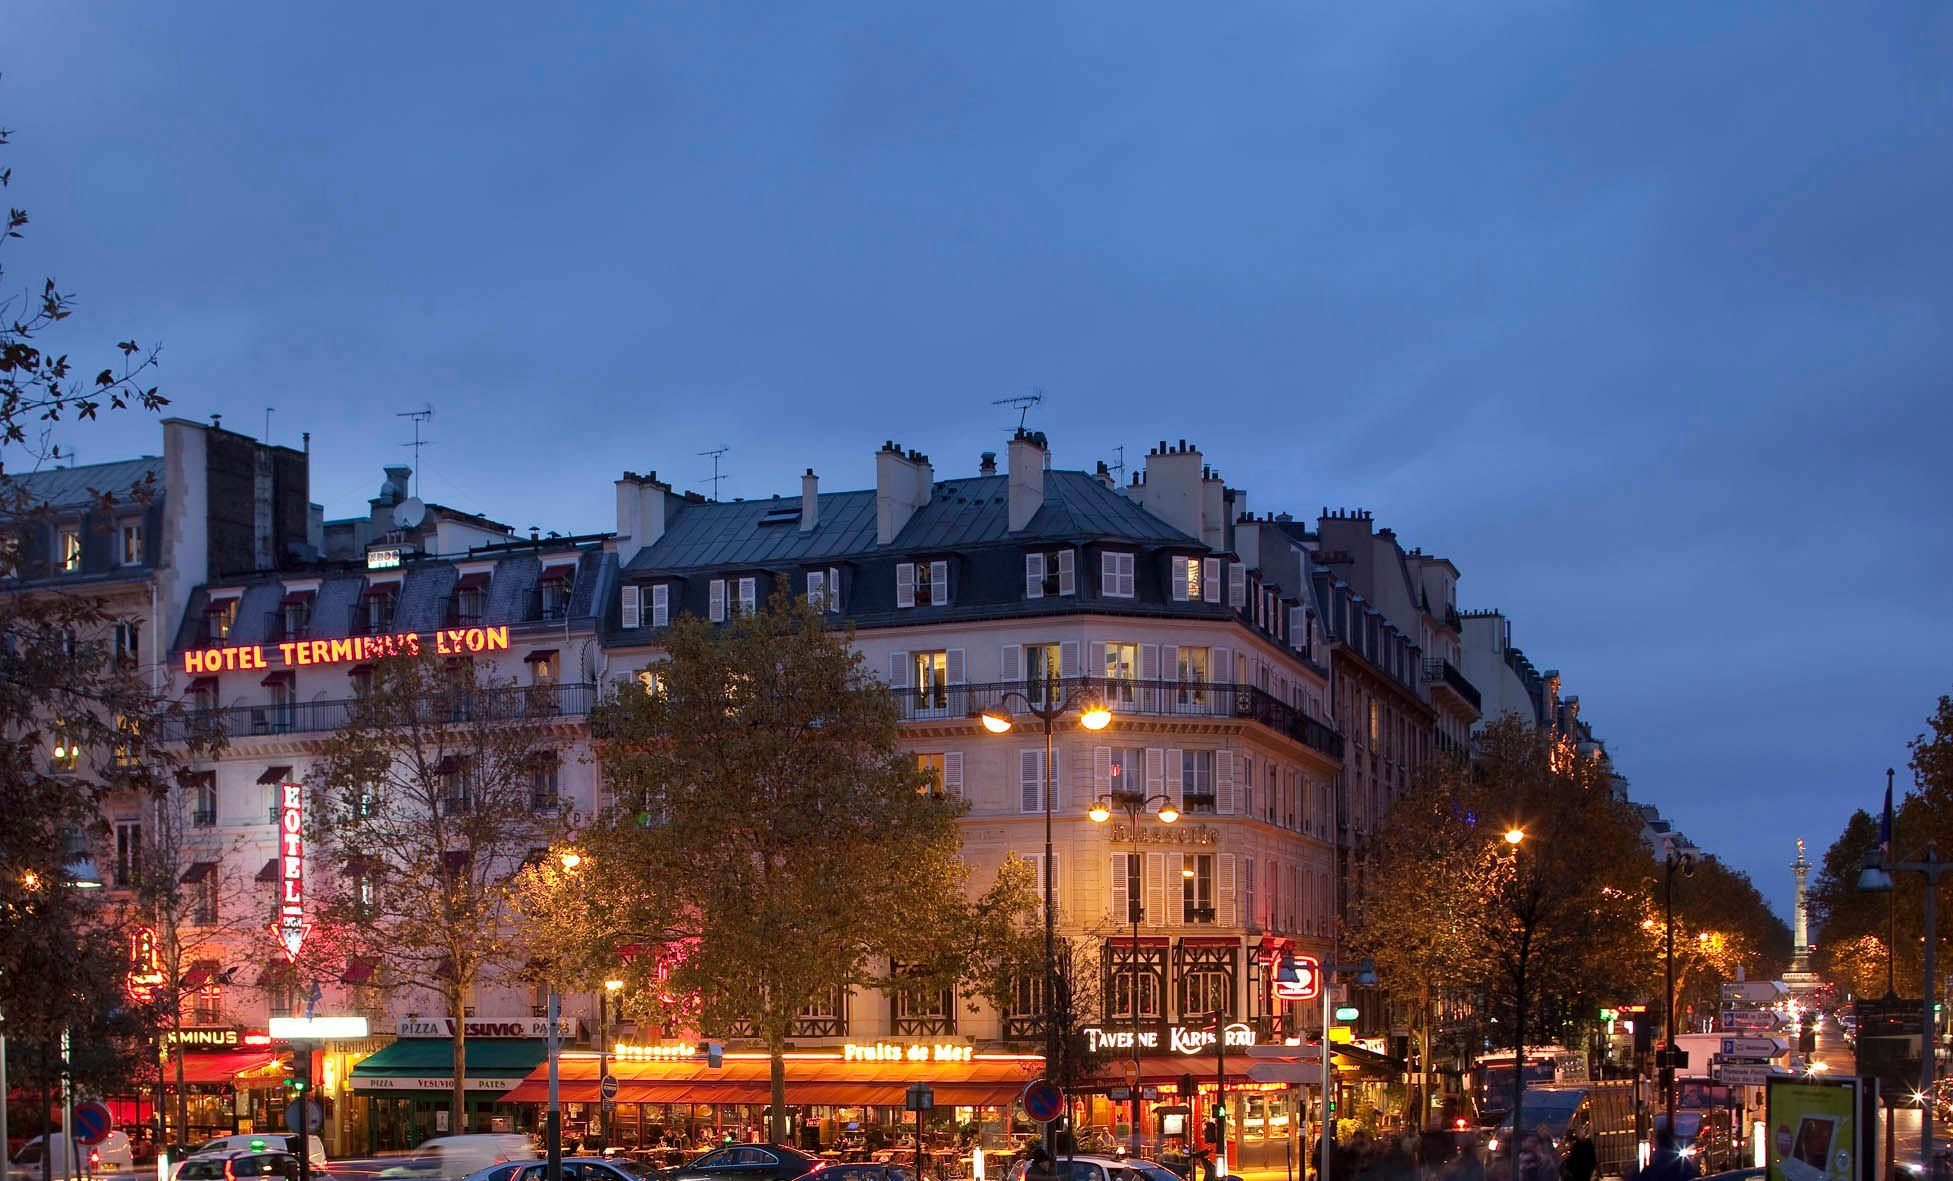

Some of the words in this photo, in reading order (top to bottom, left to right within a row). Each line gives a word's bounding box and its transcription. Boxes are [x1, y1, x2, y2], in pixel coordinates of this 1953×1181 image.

[184, 646, 268, 673] HOTEL
[279, 632, 420, 666] TERMINUS
[435, 625, 509, 655] LYON
[283, 785, 301, 903] HOTEL
[401, 1023, 439, 1034] PIZZA
[532, 1023, 570, 1034] PAS
[844, 1042, 902, 1061] Fruits
[907, 1044, 929, 1061] de
[934, 1044, 973, 1061] Mer
[370, 1079, 394, 1088] PIZZA
[417, 1079, 455, 1088] VESUVIO
[478, 1080, 506, 1088] PATES
